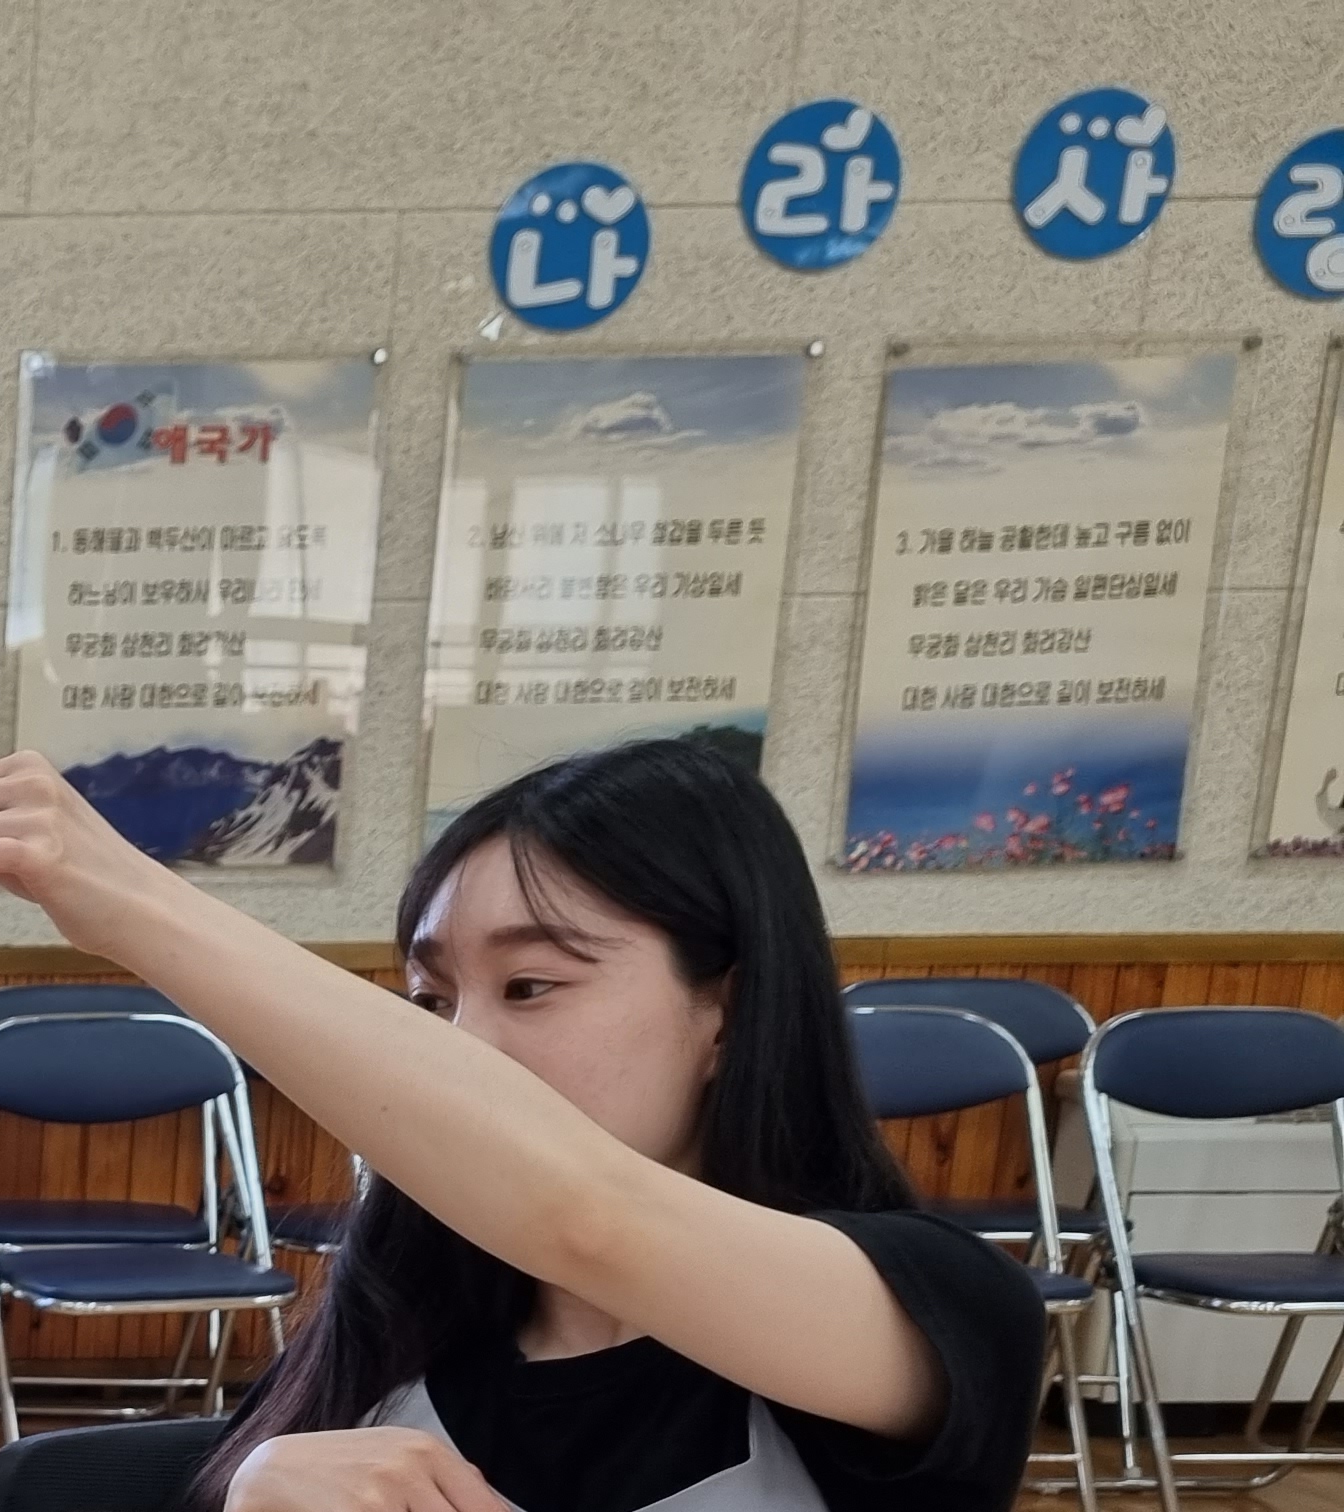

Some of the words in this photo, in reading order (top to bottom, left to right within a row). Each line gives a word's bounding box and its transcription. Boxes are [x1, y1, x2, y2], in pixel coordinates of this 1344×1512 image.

[151, 422, 272, 464] 애국가
[52, 530, 66, 553] 1.
[72, 527, 141, 554] 동해물과
[146, 525, 214, 552] 백두산이
[220, 525, 265, 551] 마르고
[652, 518, 703, 546] 철갑을
[707, 517, 744, 545] 두른
[917, 526, 955, 555] 가을
[959, 525, 995, 553] 하늘
[1000, 521, 1070, 552] 공활한데
[1074, 521, 1110, 549] 높고
[1115, 519, 1152, 548] 구름
[1155, 517, 1191, 546] 없이
[68, 579, 137, 606] 하느님이
[141, 579, 209, 604] 보우하사
[672, 570, 743, 599] 기상일세
[913, 580, 948, 608] 밝은
[952, 579, 988, 606] 달은
[993, 576, 1029, 604] 우리
[1032, 575, 1068, 603] 가슴
[1073, 570, 1178, 602] 일편단심일세
[66, 631, 116, 658] 무궁화
[121, 631, 173, 657] 삼천리
[479, 627, 531, 654] 무궁화
[535, 626, 587, 653] 삼천리
[591, 625, 663, 652] 화려강산
[907, 632, 960, 659] 무궁화
[964, 629, 1017, 658] 삼천리
[1021, 627, 1092, 656] 화려강산
[63, 683, 96, 709] 대한
[100, 683, 136, 709] 사람
[139, 682, 208, 709] 대한으로
[213, 682, 243, 708] 길이
[475, 679, 510, 705] 대한
[514, 678, 549, 705] 사람
[553, 677, 625, 705] 대한으로
[628, 675, 661, 702] 길이
[667, 674, 737, 702] 보전하세
[901, 684, 938, 711] 대한
[941, 682, 978, 710] 사람
[981, 679, 1052, 709] 대한으로
[1056, 677, 1092, 706] 길이
[1096, 675, 1166, 705] 보전하세
